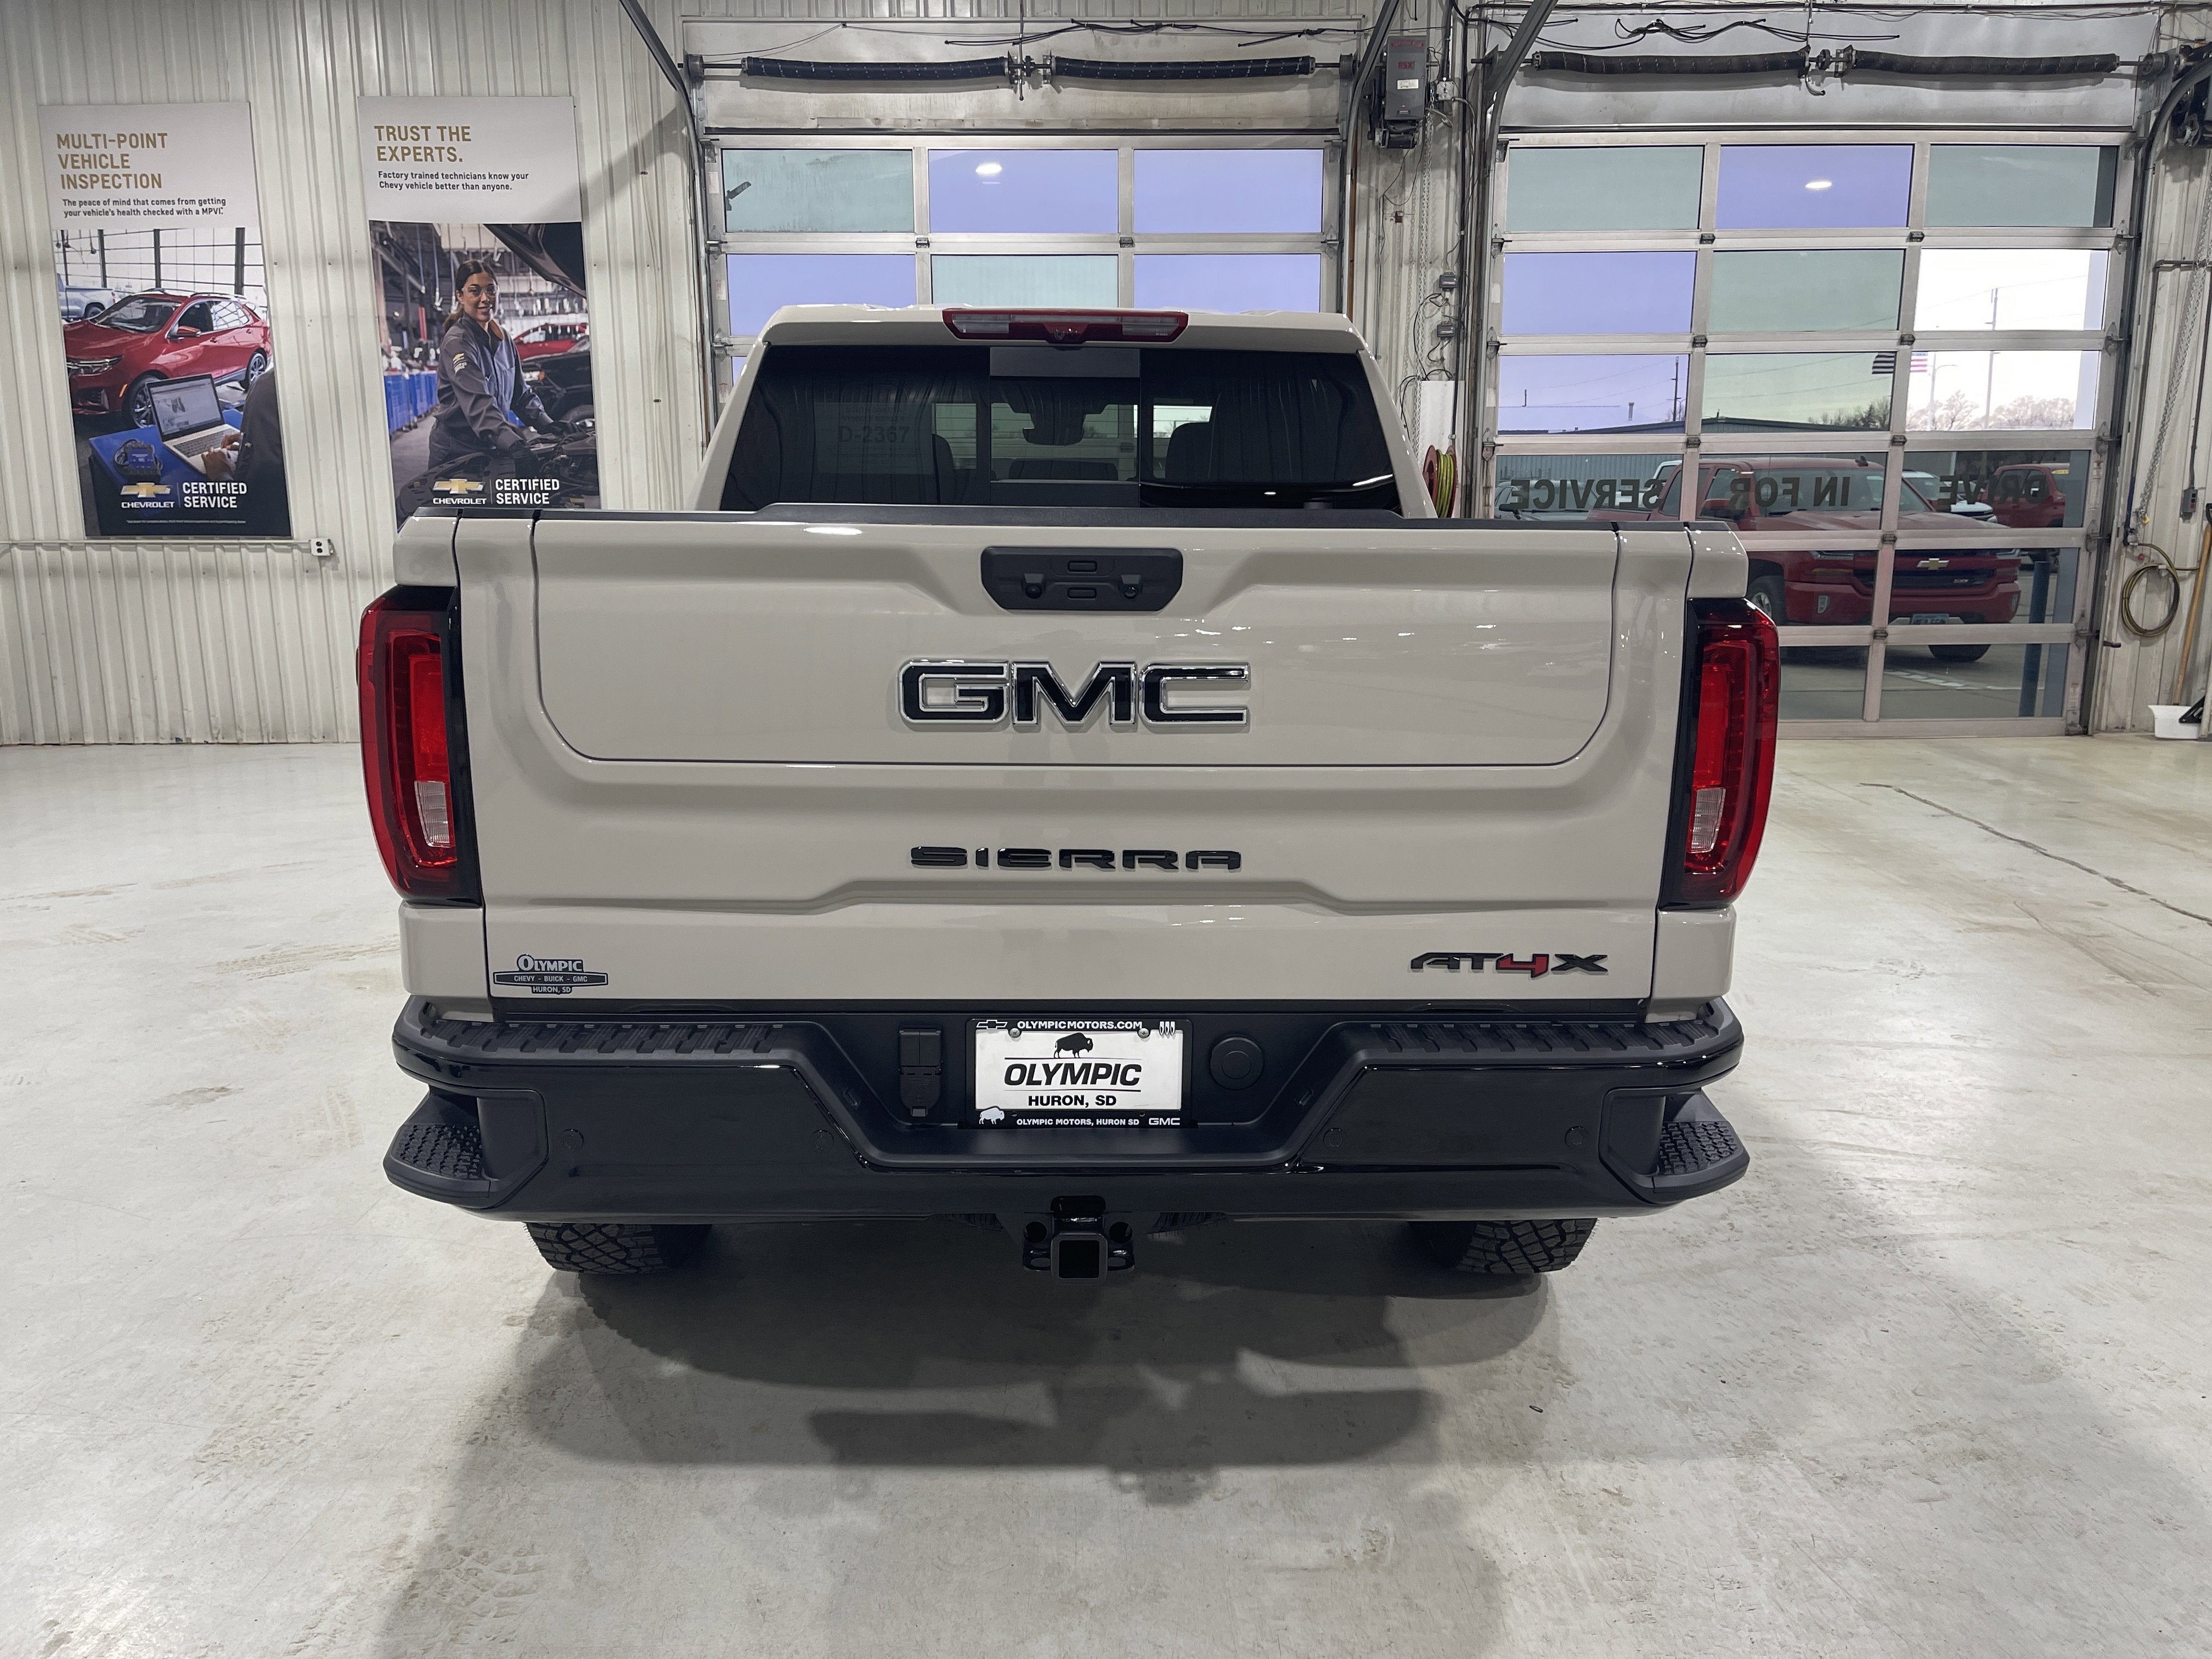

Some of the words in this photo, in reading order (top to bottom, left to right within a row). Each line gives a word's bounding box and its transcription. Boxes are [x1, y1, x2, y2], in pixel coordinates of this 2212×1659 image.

[57, 133, 167, 149] MULTI-POINT
[374, 126, 431, 142] TRUST
[437, 126, 471, 142] THE
[58, 154, 130, 169] VEHICLE
[377, 146, 463, 162] EXPERTS.
[61, 174, 162, 189] INSPECTION
[379, 171, 409, 180] Factory
[379, 181, 403, 190] Chevy
[78, 200, 100, 208] peace
[198, 197, 226, 206] getting
[838, 426, 910, 443] D-2367
[182, 482, 247, 494] CERTIFIED
[495, 479, 560, 490] CERTIFIED
[184, 496, 238, 509] SERVICE
[496, 493, 550, 504] SERVICE
[899, 659, 1251, 725] GMC
[911, 847, 1242, 870] SIERRA
[518, 955, 583, 972] OLYMPIC
[1410, 952, 1608, 978] AT4X
[1017, 1021, 1143, 1030] OLYMPICMOTORS.COM
[1004, 1063, 1142, 1086] OLYMPIC
[1028, 1094, 1090, 1108] HURON,
[1094, 1094, 1117, 1107] SD
[1056, 1118, 1094, 1126] MOTORS,
